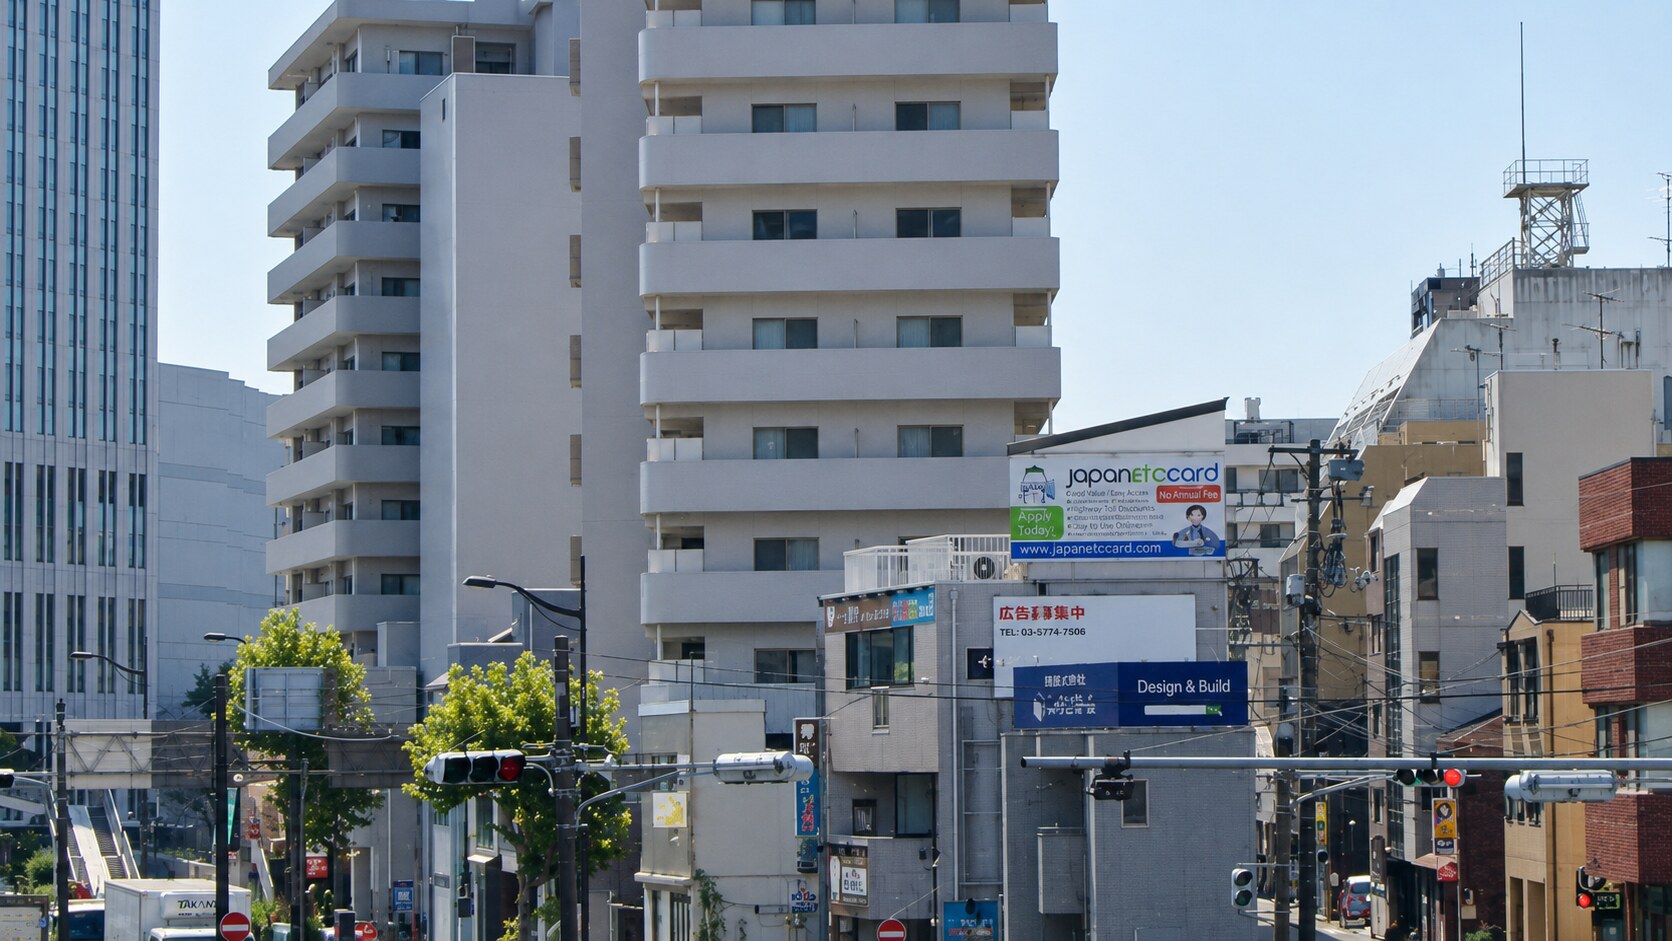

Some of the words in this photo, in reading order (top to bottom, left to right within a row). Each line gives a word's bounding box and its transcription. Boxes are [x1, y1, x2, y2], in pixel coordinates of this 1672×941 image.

[1159, 491, 1172, 500] No
[1173, 490, 1202, 500] Annual
[1203, 489, 1218, 500] Fee
[1018, 509, 1052, 524] Apply
[1020, 542, 1162, 557] www.japanetccard.com
[1000, 628, 1019, 637] TEL:
[1021, 628, 1086, 637] 03-5774-7506
[1137, 679, 1182, 697] Design
[1185, 679, 1195, 693] &
[1199, 679, 1231, 693] Build
